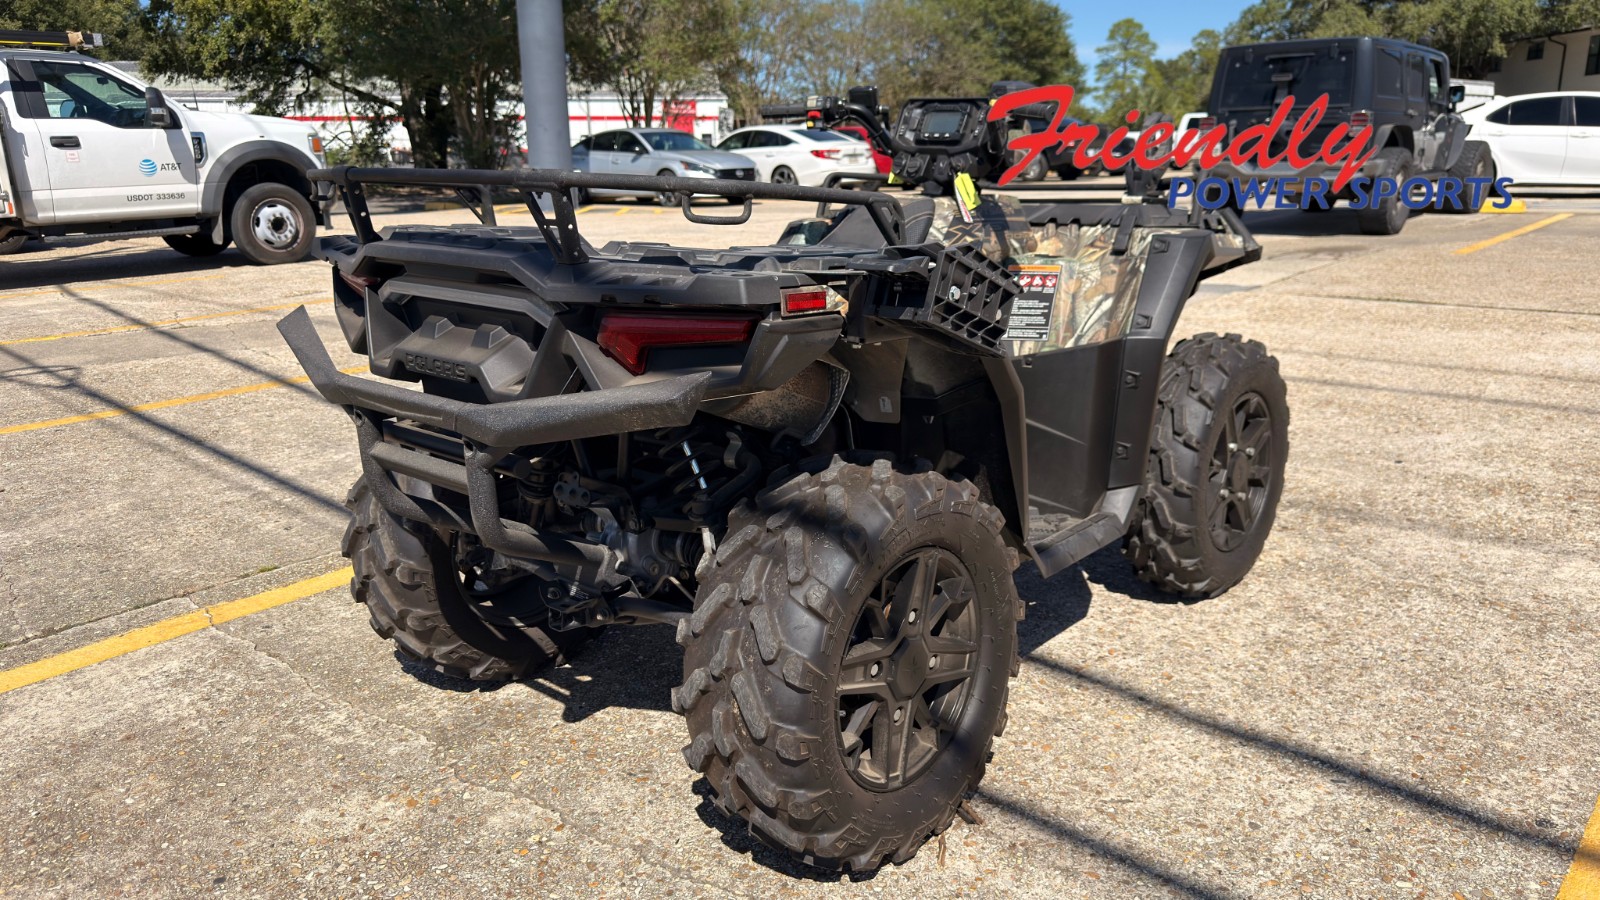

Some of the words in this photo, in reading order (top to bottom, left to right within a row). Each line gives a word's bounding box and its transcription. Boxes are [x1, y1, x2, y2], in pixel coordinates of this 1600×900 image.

[160, 162, 182, 171] AT&T
[126, 194, 154, 202] USDOT
[156, 192, 186, 200] 333636
[405, 352, 467, 381] POLARIS
